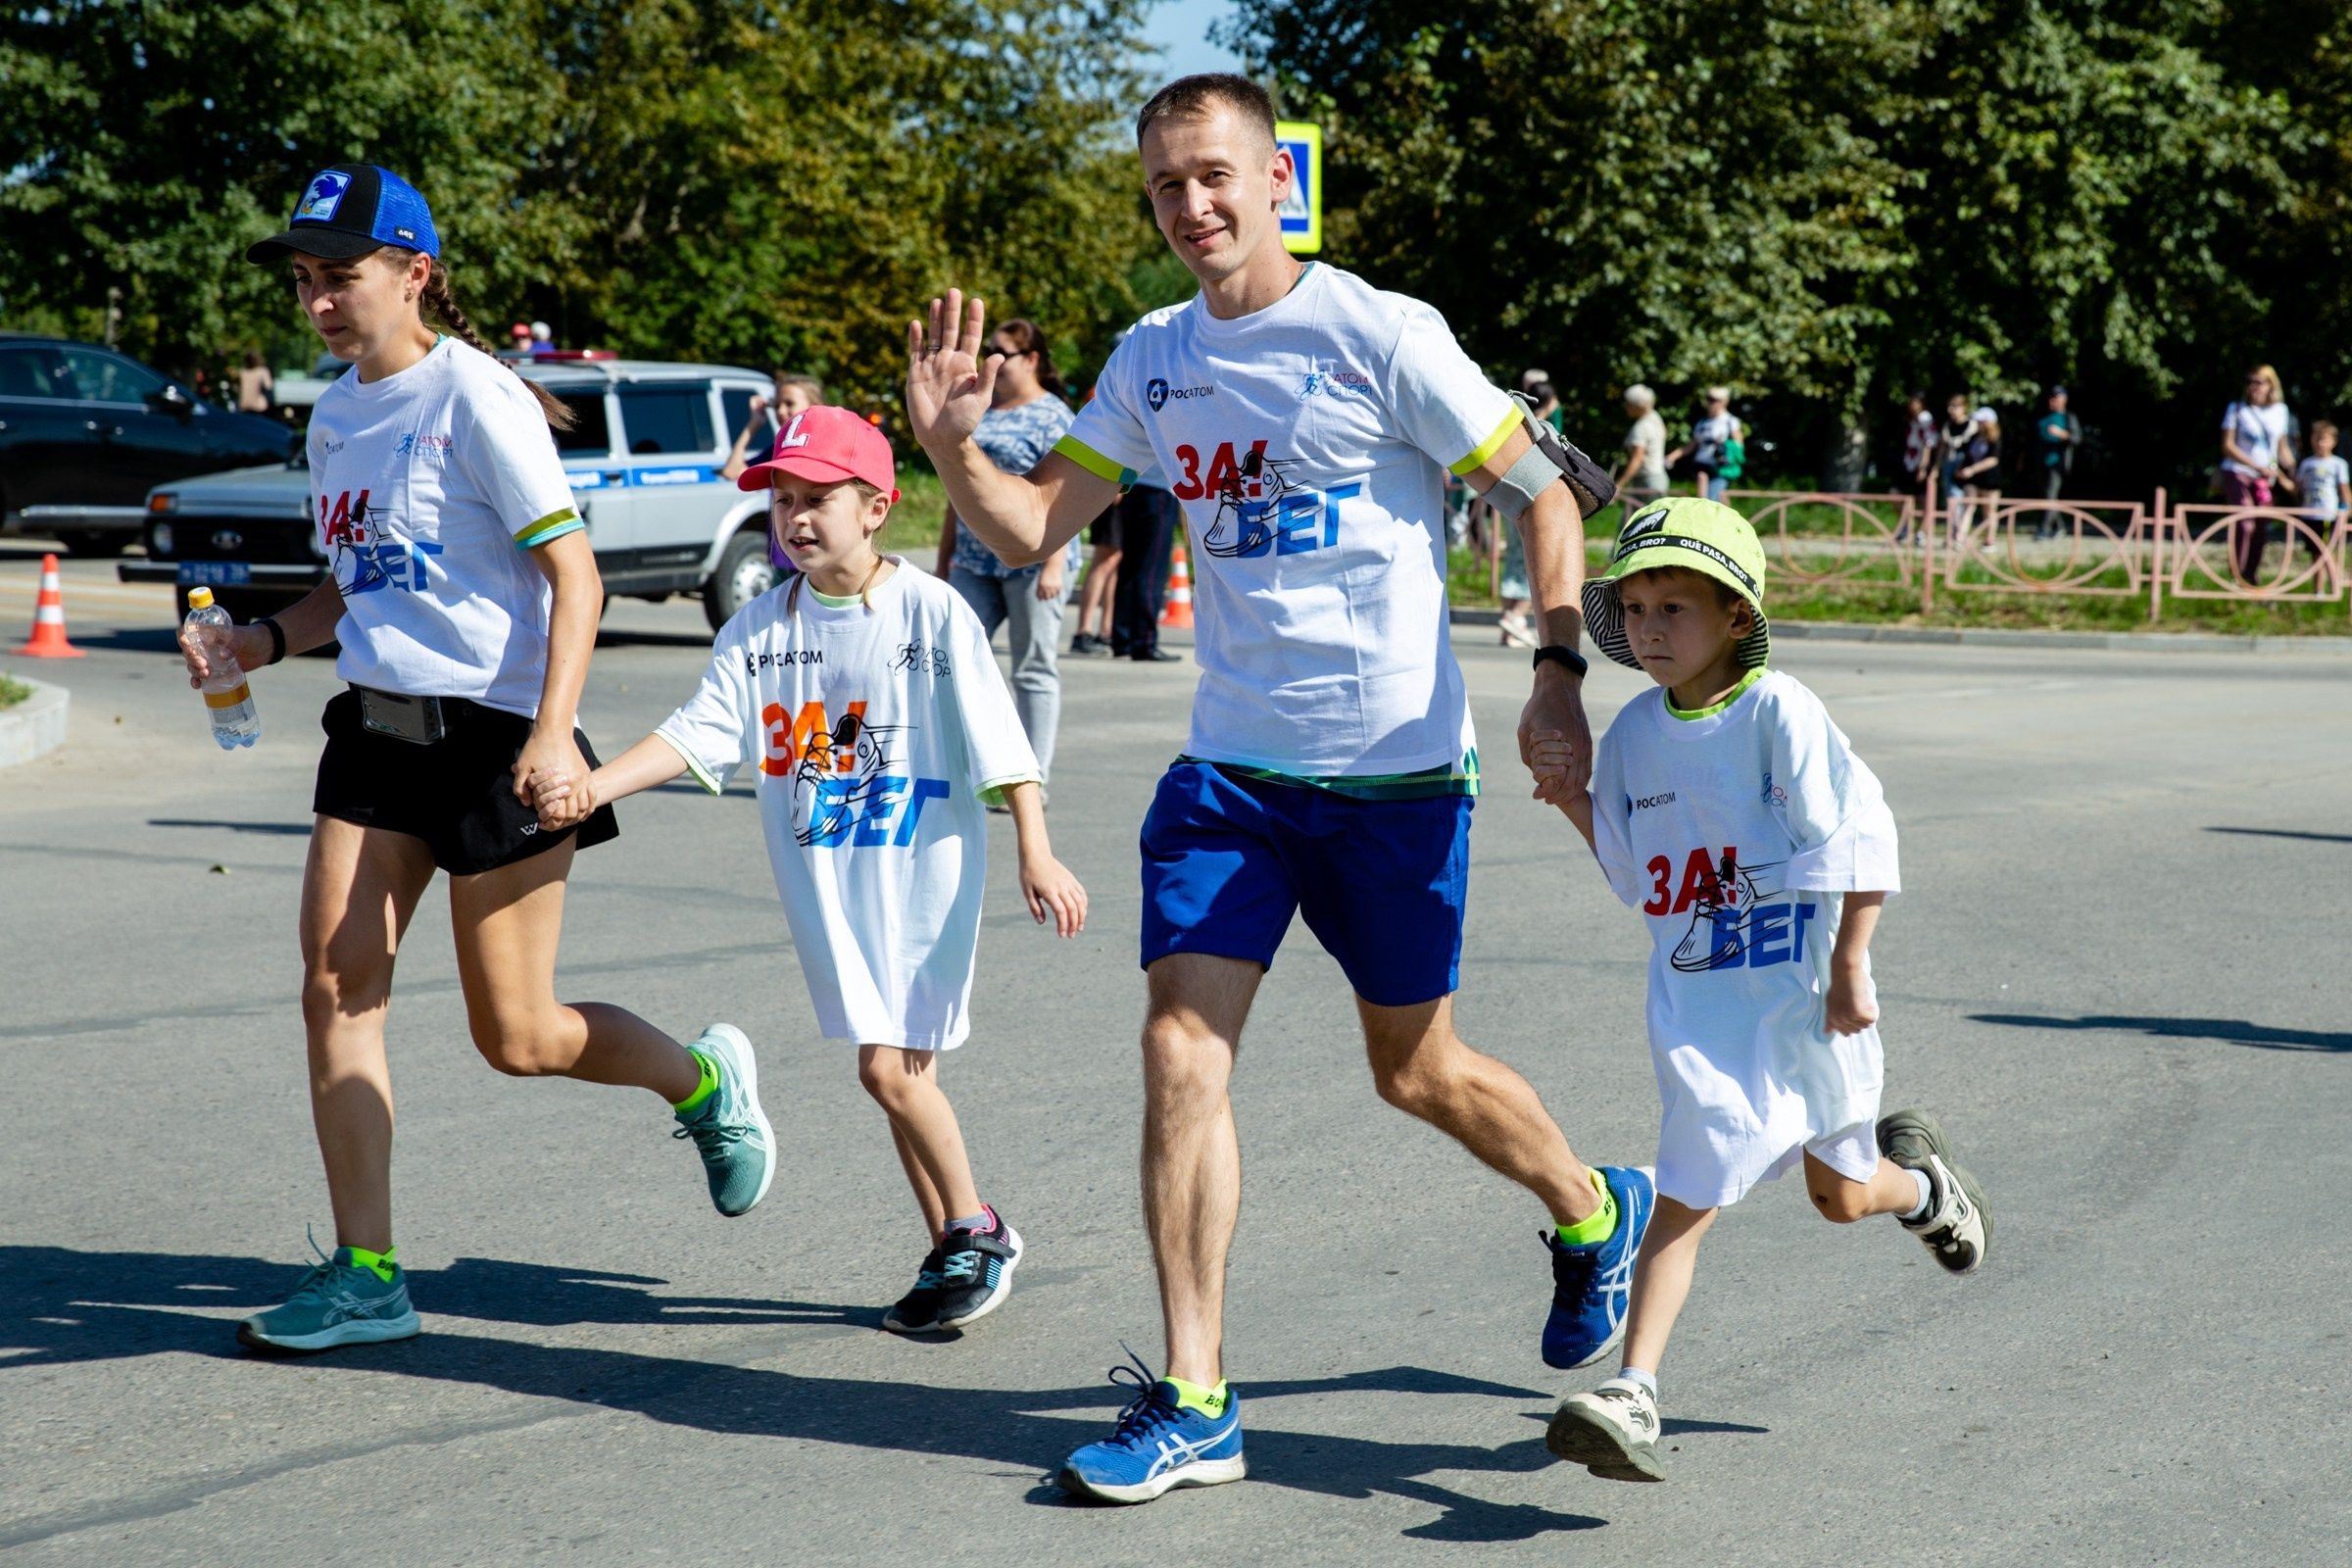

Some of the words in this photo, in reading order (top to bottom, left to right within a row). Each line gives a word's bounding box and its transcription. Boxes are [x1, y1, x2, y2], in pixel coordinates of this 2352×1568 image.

[1170, 385, 1215, 400] РОСАТОМ
[1333, 372, 1369, 385] АТОМ
[414, 446, 454, 459] СПОРТ
[420, 435, 453, 449] АТОМ
[781, 414, 809, 449] L
[1173, 440, 1268, 501] ЗА!
[1237, 482, 1362, 559] БЕГ
[352, 541, 444, 595] БЕГ
[1639, 537, 1666, 548] BRO?
[1680, 538, 1702, 552] QUÉ
[1702, 546, 1730, 568] PASA,
[1728, 561, 1748, 583] BRO?
[760, 701, 868, 777] ЗА!
[808, 775, 951, 849] БЕГ
[1636, 791, 1677, 810] РОСАТОМ
[1643, 847, 1738, 916] ЗА!
[1709, 902, 1817, 971] БЕГ
